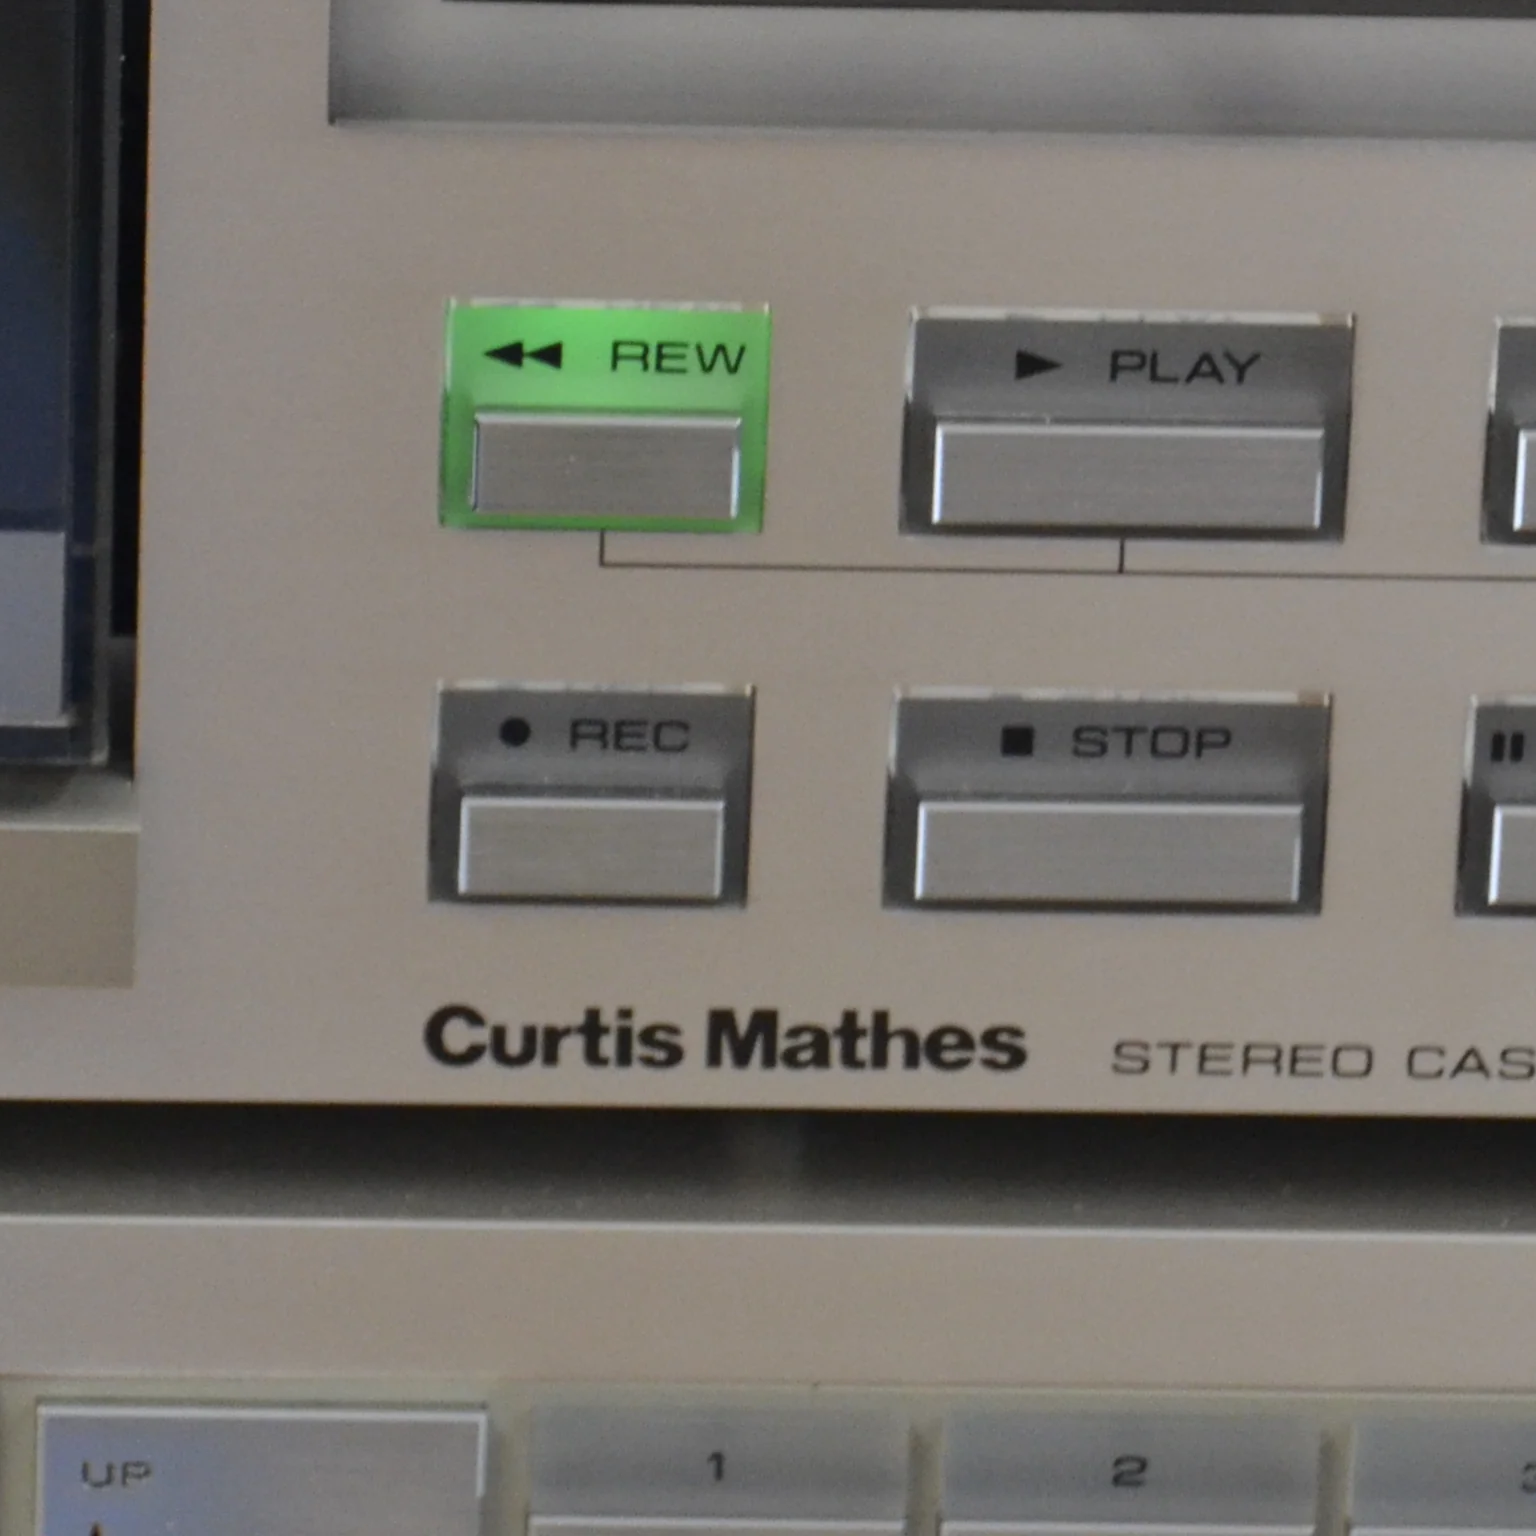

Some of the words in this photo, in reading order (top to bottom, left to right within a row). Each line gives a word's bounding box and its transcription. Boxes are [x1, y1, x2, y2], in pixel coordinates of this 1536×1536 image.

[611, 340, 747, 375] REW
[1109, 349, 1261, 384] PLAY
[569, 717, 691, 752] REC
[1072, 725, 1233, 759] STOP
[423, 1004, 685, 1069] Curtis
[706, 1008, 1028, 1072] Mathes
[1112, 1040, 1374, 1078] STEREO
[80, 1460, 152, 1489] UP
[708, 1451, 725, 1482] 1
[1111, 1455, 1149, 1488] 2
